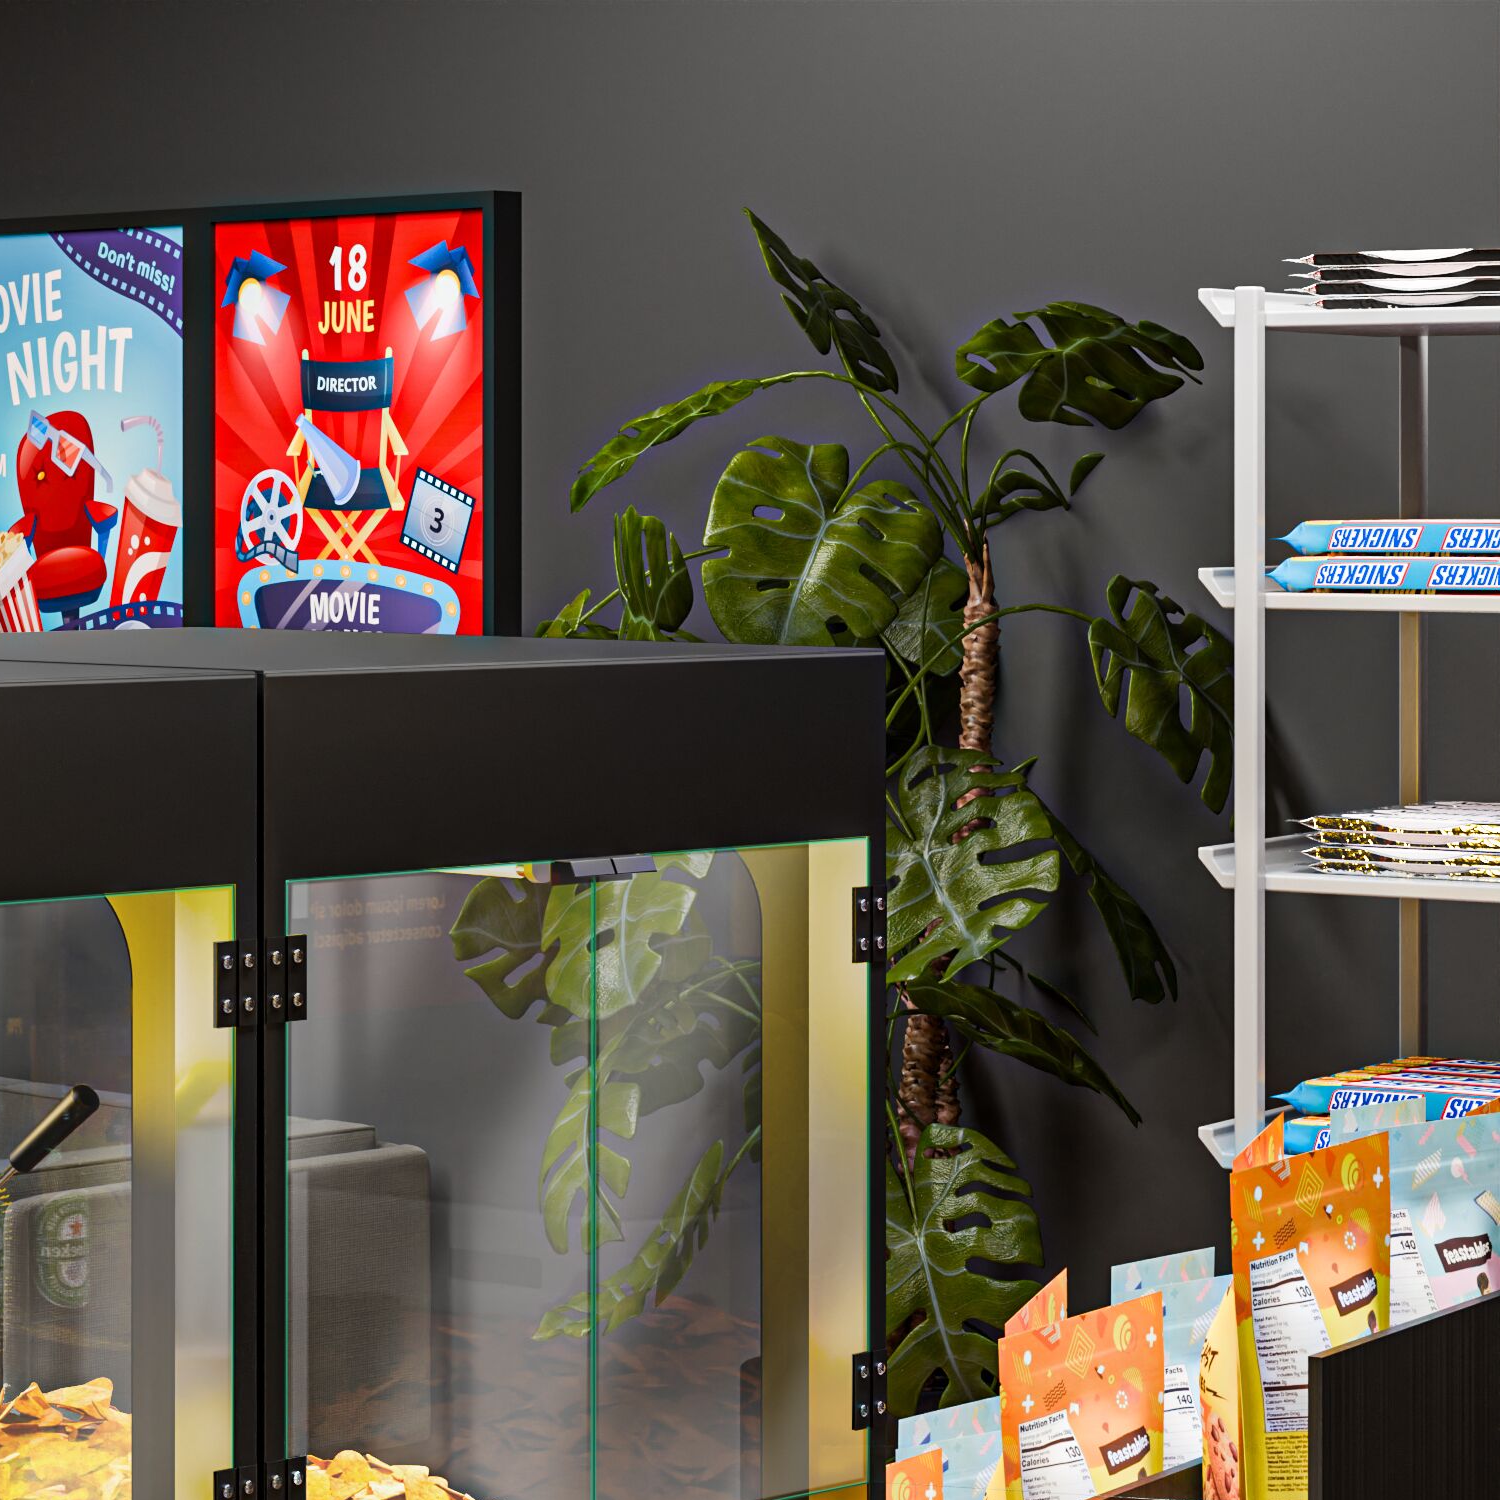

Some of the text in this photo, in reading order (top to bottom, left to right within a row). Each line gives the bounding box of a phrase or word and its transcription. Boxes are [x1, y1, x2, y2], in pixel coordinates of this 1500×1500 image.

[97, 241, 176, 296] Don't miss!
[328, 243, 367, 292] 18
[317, 299, 375, 335] JUNE
[6, 325, 133, 406] NIGHT
[316, 375, 377, 393] DIRECTOR
[429, 507, 445, 534] 3
[1331, 527, 1418, 548] SNICKERS
[1445, 527, 1500, 549] CKERS
[1317, 564, 1404, 585] SNICKERS
[309, 591, 381, 625] MOVIE
[1400, 1239, 1416, 1250] 140
[1442, 1240, 1490, 1265] feastables
[1250, 1252, 1294, 1271] Nutrition Facts
[1252, 1285, 1312, 1307] Calories 130
[1165, 1367, 1183, 1375] Facts
[1176, 1394, 1193, 1405] 140
[1020, 1413, 1065, 1432] Nutrition Facts
[1021, 1445, 1081, 1468] Calories 130
[1107, 1434, 1150, 1467] feastables
